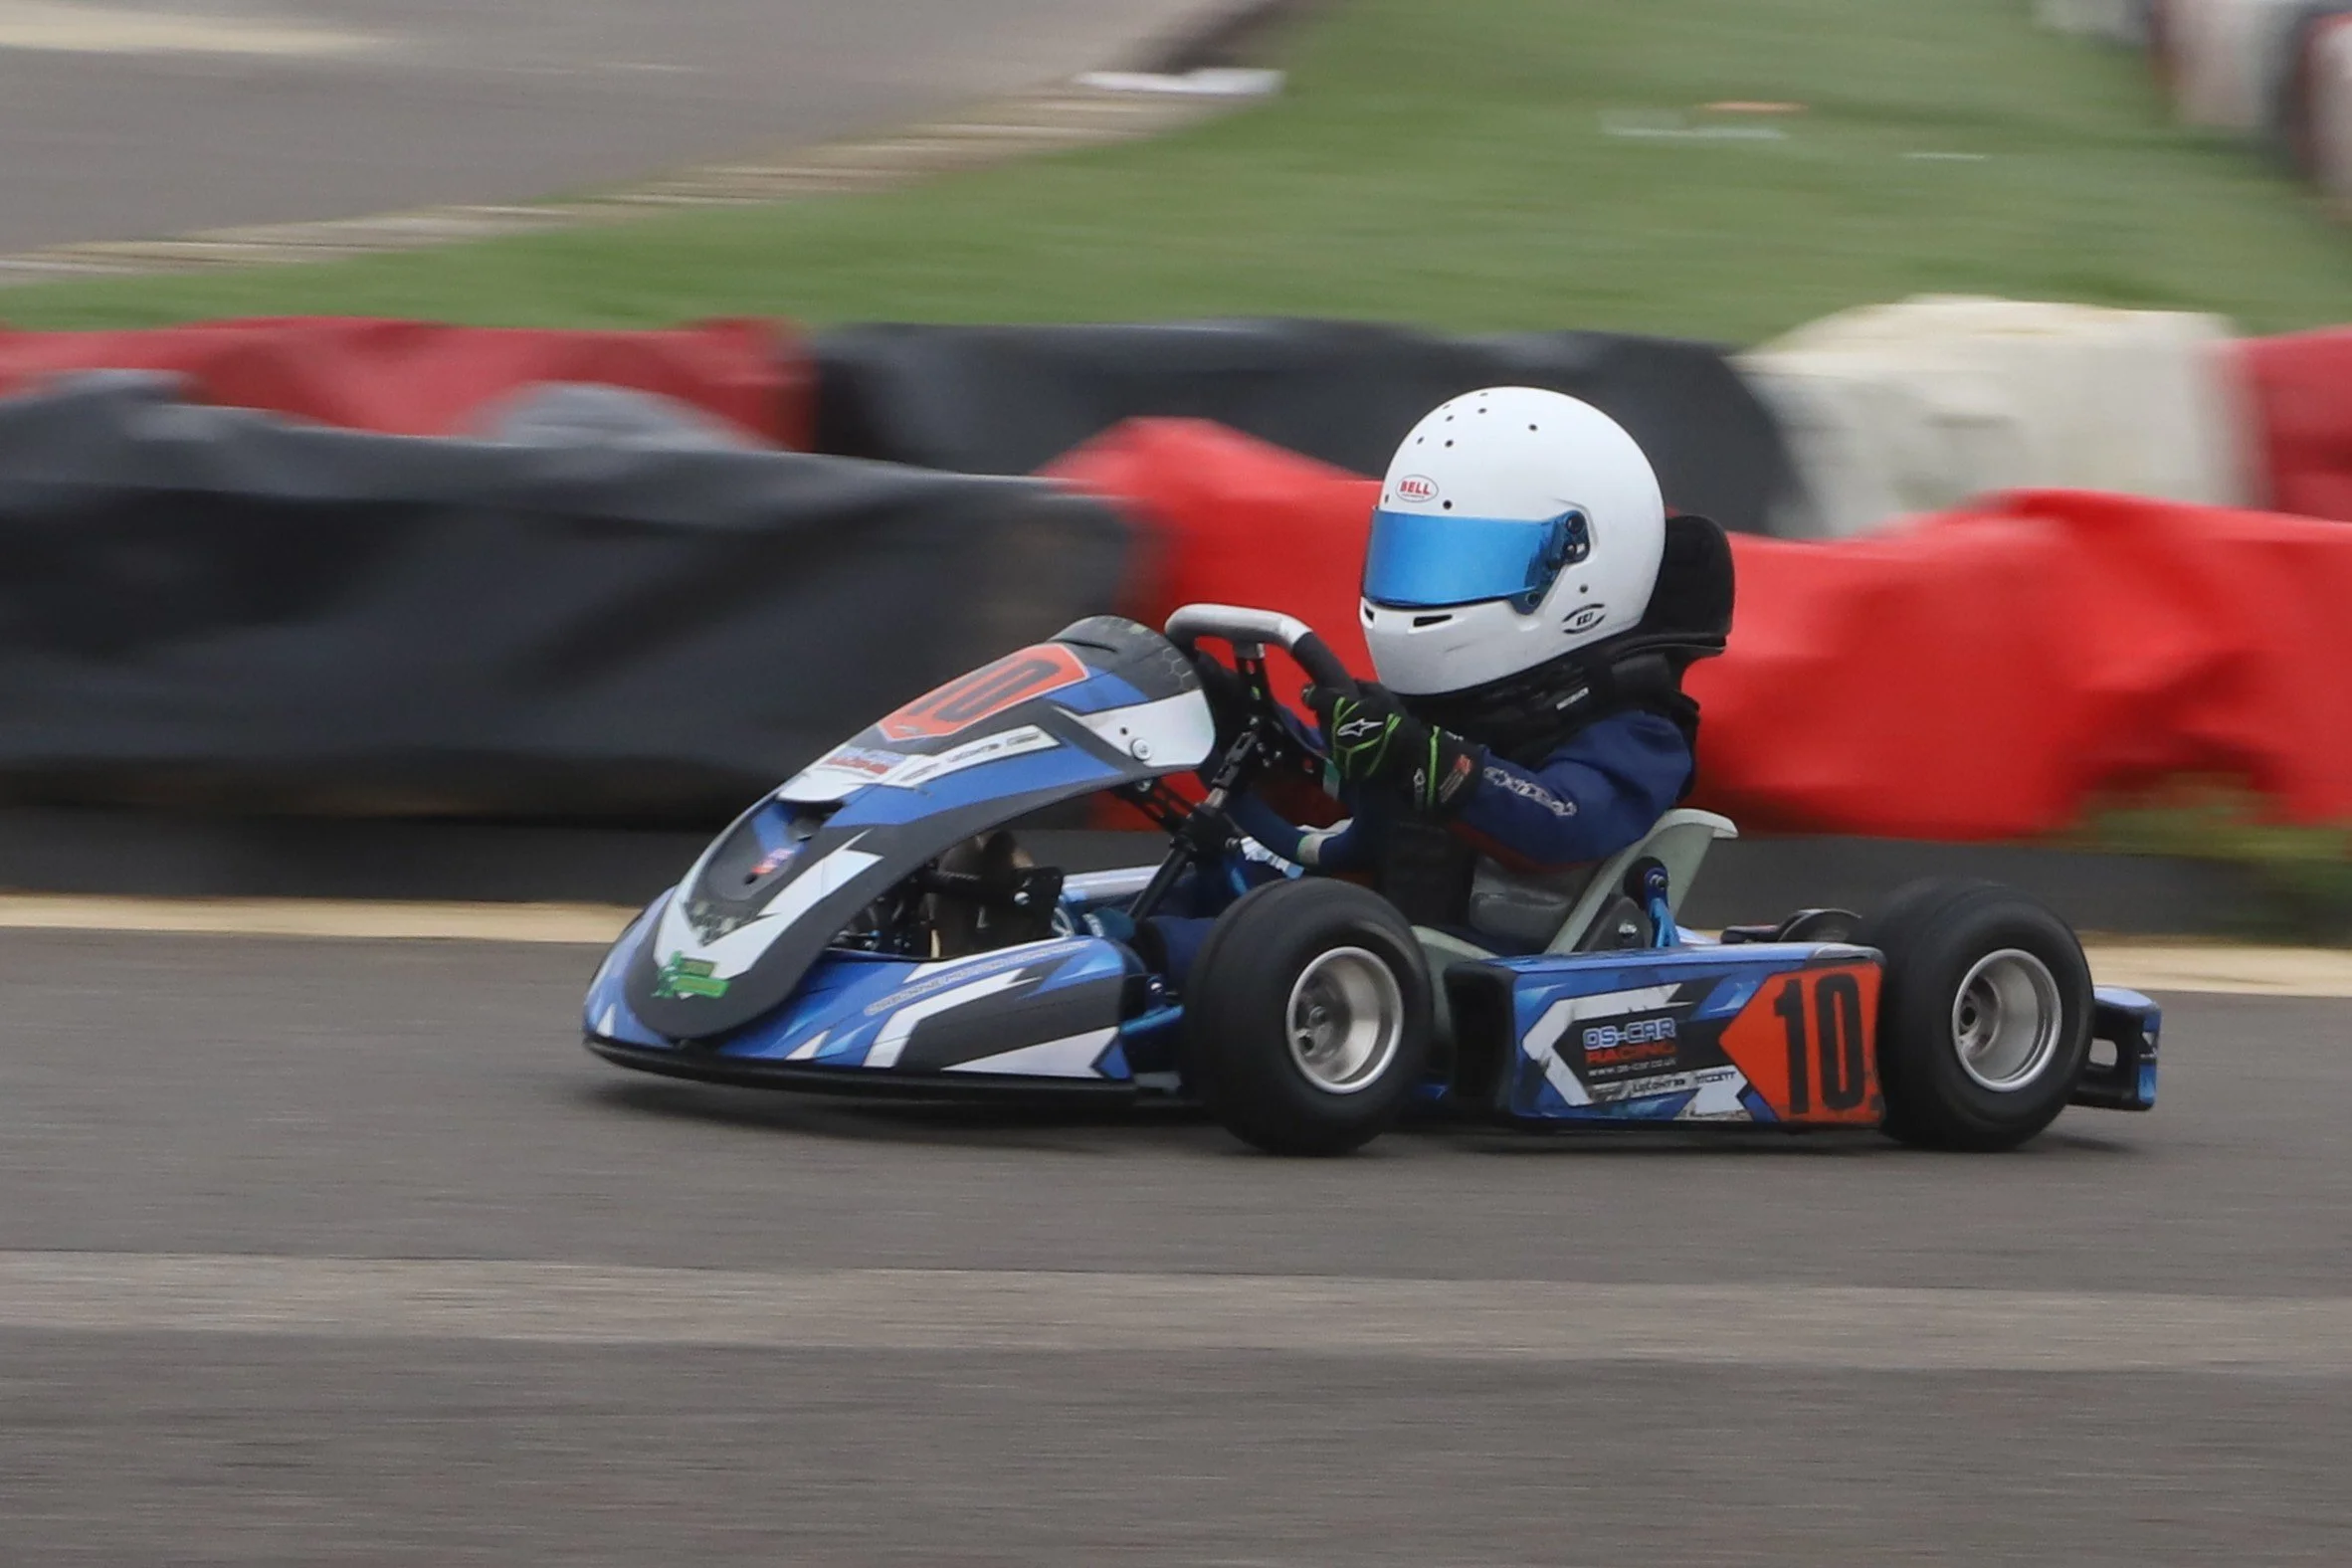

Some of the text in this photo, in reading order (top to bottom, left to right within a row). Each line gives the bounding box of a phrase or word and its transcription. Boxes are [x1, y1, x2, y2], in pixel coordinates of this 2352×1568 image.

[1400, 481, 1430, 495] BELL
[907, 657, 1061, 721] 10
[1583, 1018, 1676, 1051] OS-CAR
[1774, 972, 1865, 1114] 10
